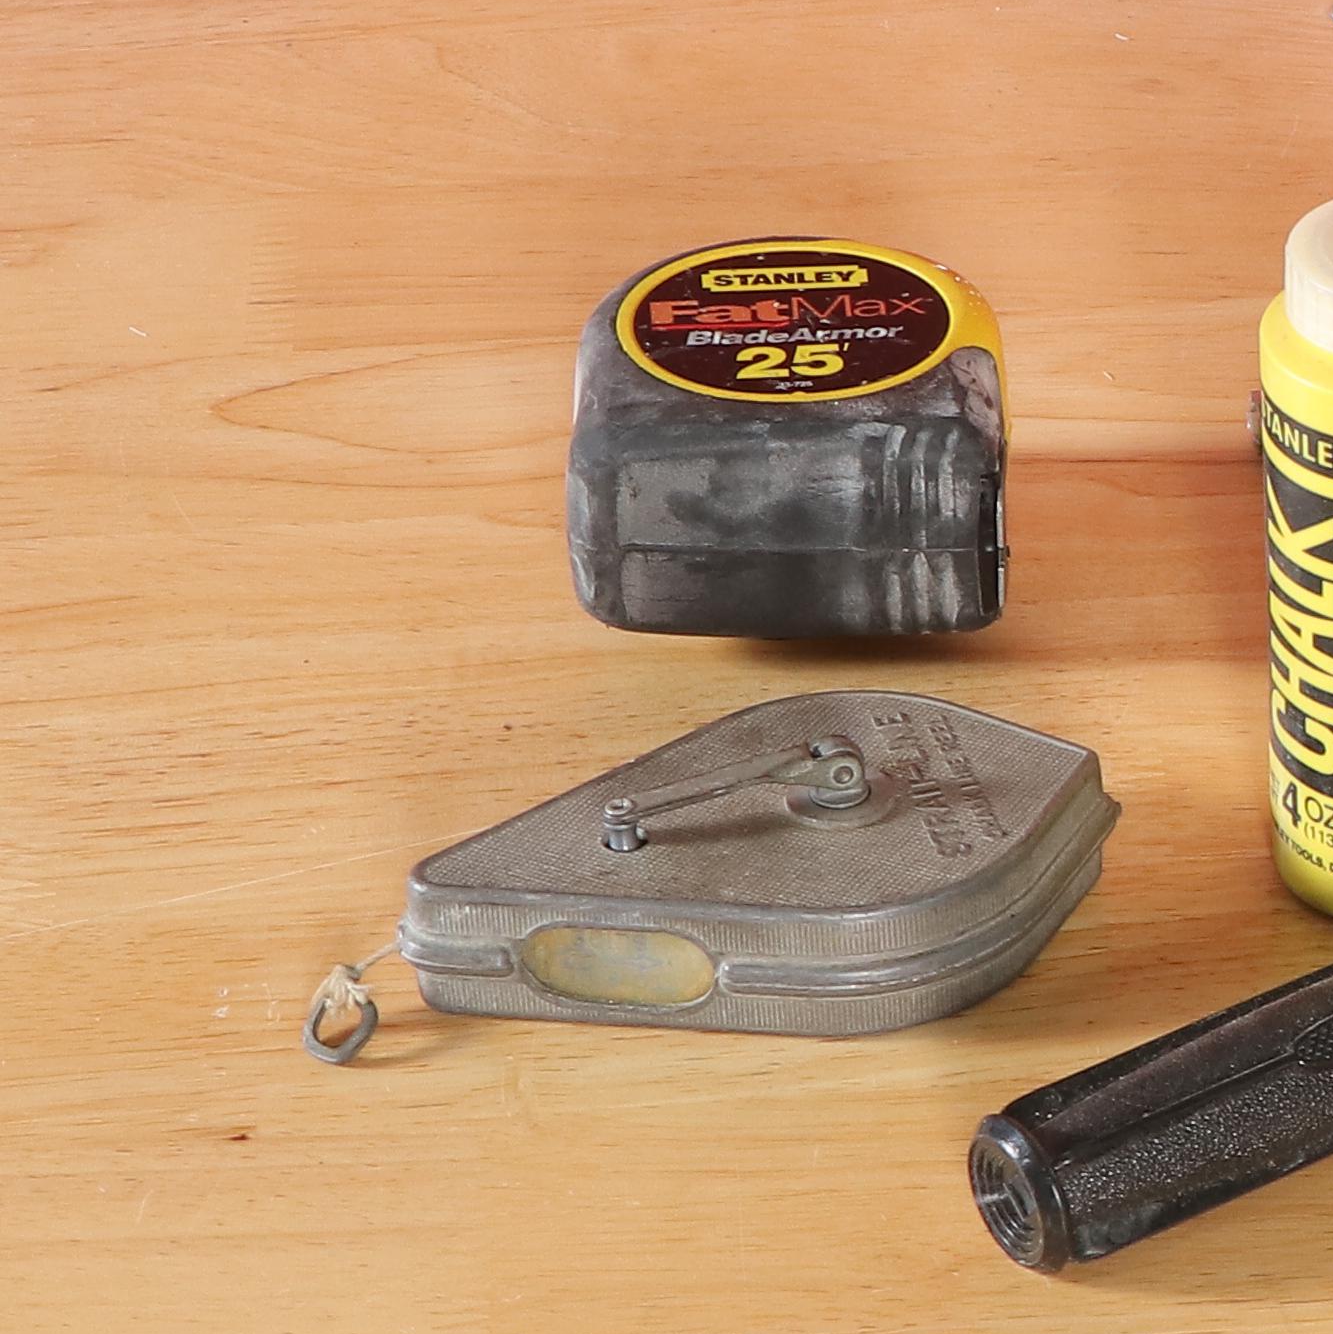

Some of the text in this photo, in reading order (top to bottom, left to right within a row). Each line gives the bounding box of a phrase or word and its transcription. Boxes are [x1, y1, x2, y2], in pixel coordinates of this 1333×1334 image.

[713, 271, 856, 287] STANLEY
[650, 294, 926, 325] FatMax
[686, 324, 904, 347] BladeArmor
[736, 342, 849, 379] 25'
[1282, 781, 1301, 828] 4
